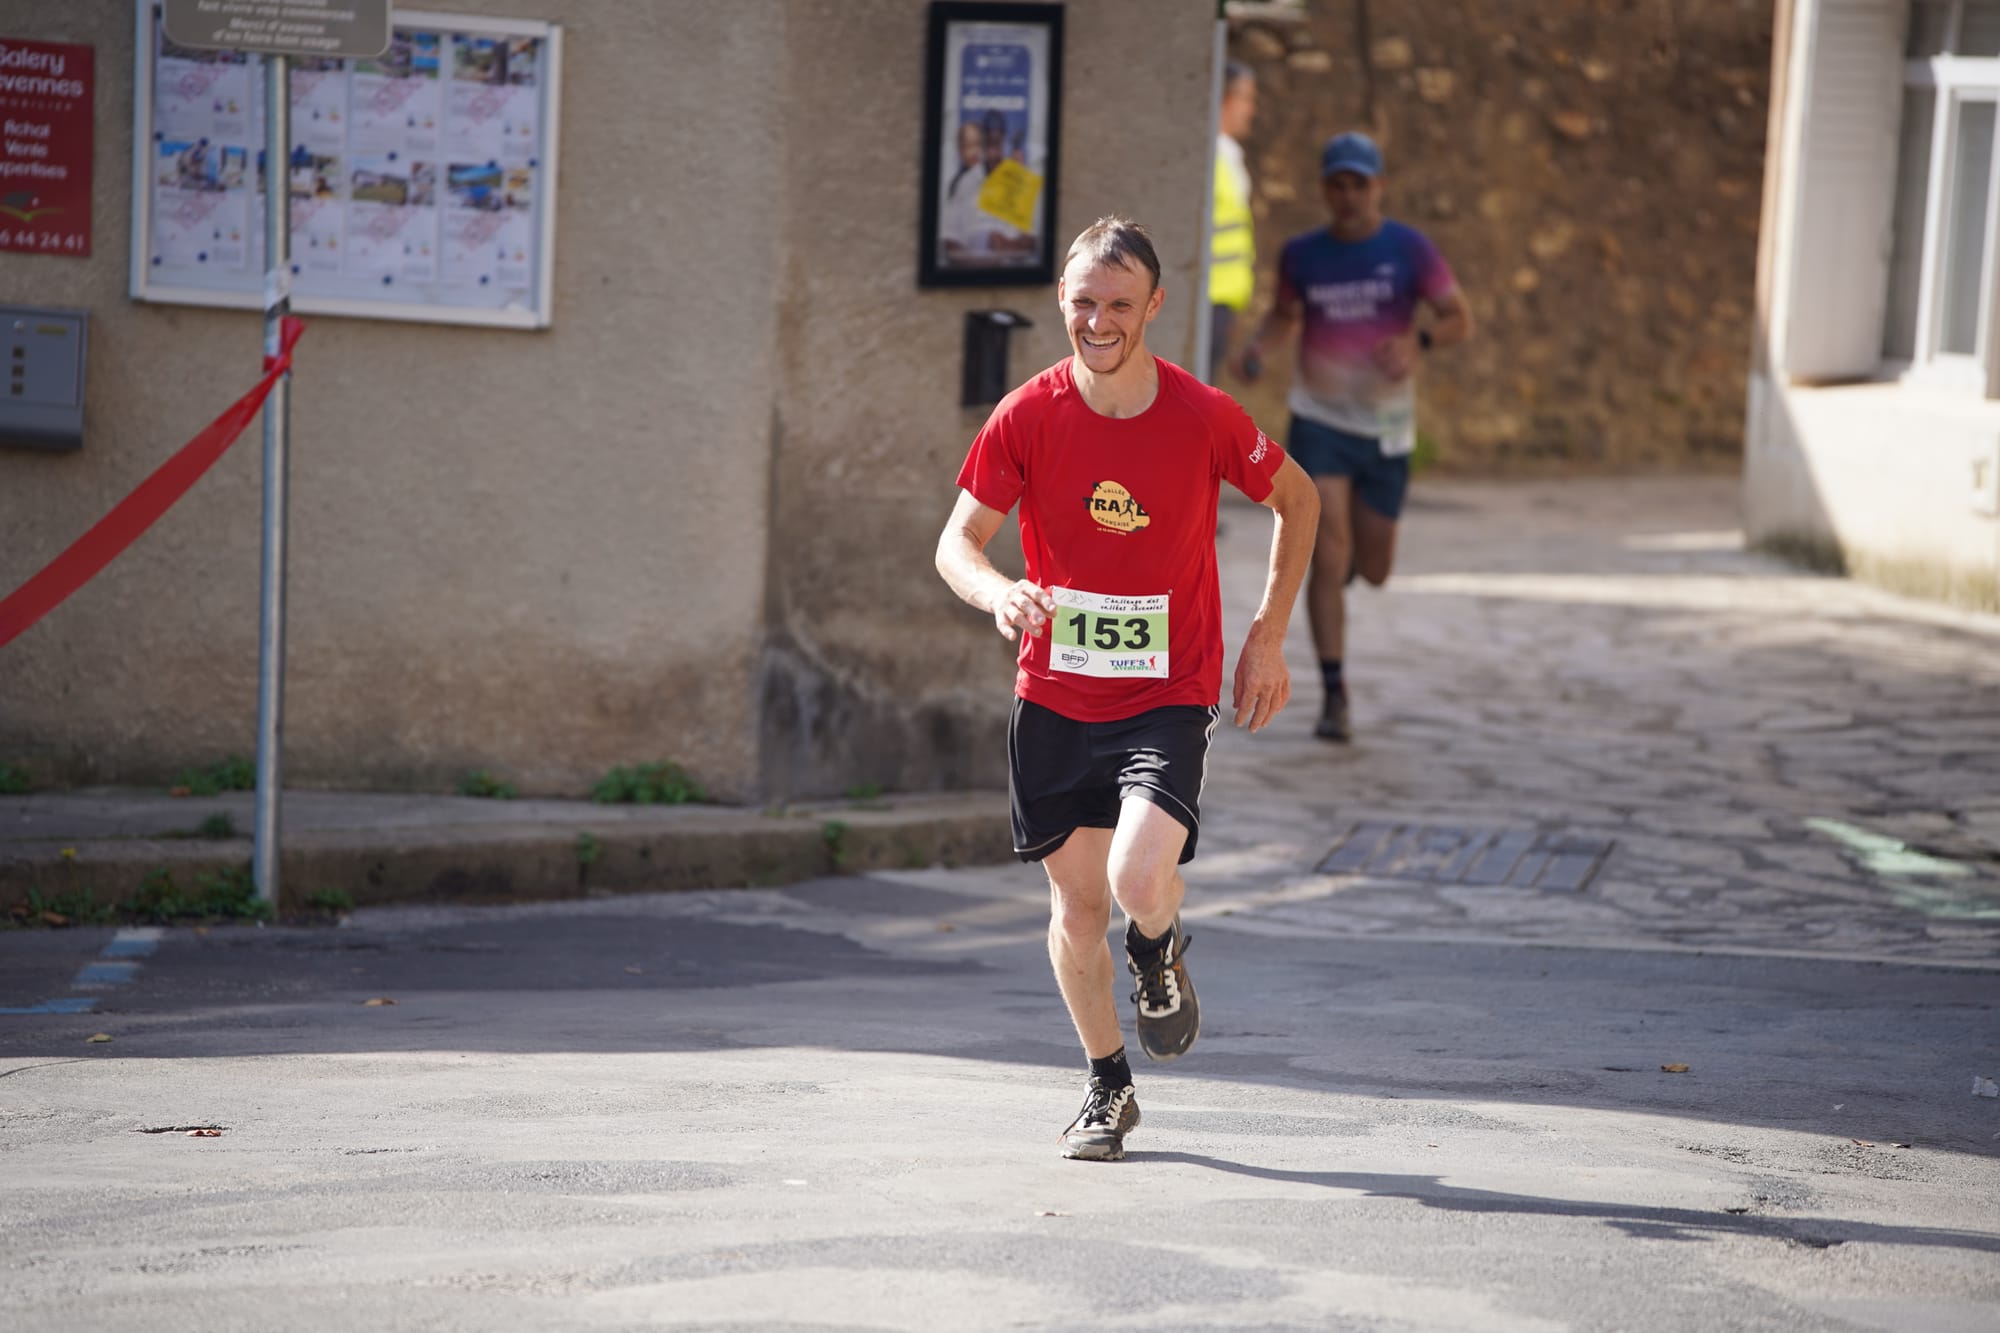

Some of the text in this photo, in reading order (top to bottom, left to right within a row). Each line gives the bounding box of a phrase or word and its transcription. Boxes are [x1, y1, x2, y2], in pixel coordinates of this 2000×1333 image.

[229, 17, 267, 31] Merci
[4, 139, 48, 157] Vente
[15, 230, 35, 247] 44
[40, 231, 60, 249] 24
[65, 233, 84, 250] 41
[1105, 597, 1142, 606] Challenge
[1069, 612, 1151, 650] 153
[1110, 658, 1146, 667] TUFF'S
